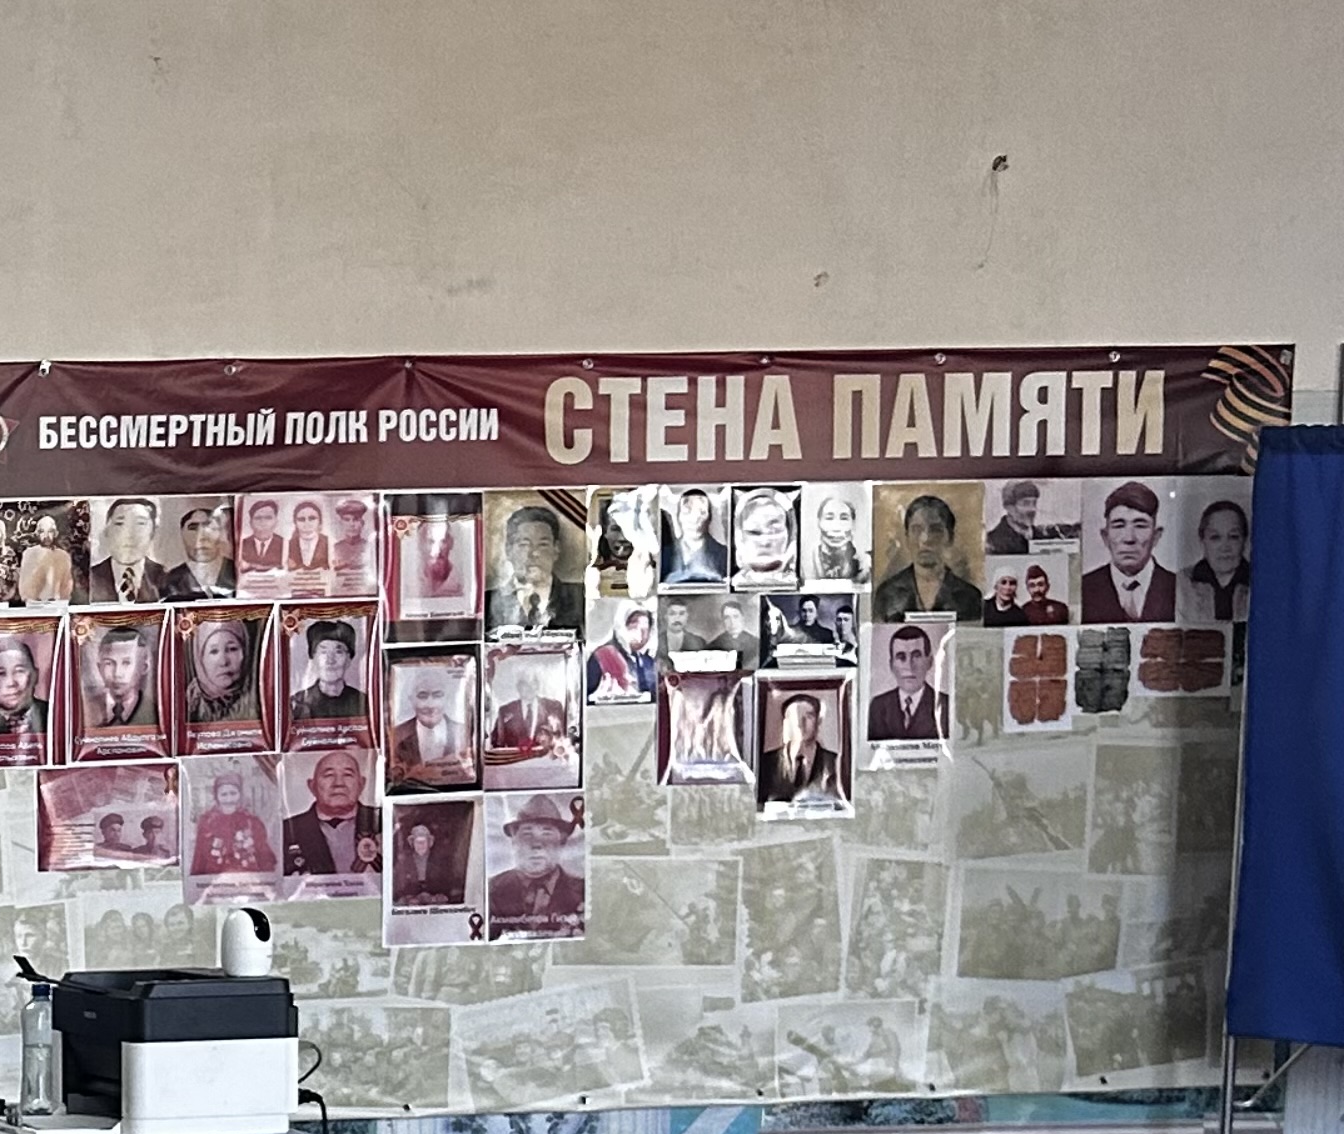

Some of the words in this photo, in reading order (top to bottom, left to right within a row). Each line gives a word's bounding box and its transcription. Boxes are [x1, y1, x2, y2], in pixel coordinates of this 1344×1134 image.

[38, 408, 276, 450] БЕССМЕРТНЫЙ
[284, 410, 369, 447] ПОЛК
[377, 407, 500, 443] РОССИИ
[543, 374, 803, 466] СТЕНА
[832, 369, 1166, 460] ПАМЯТИ
